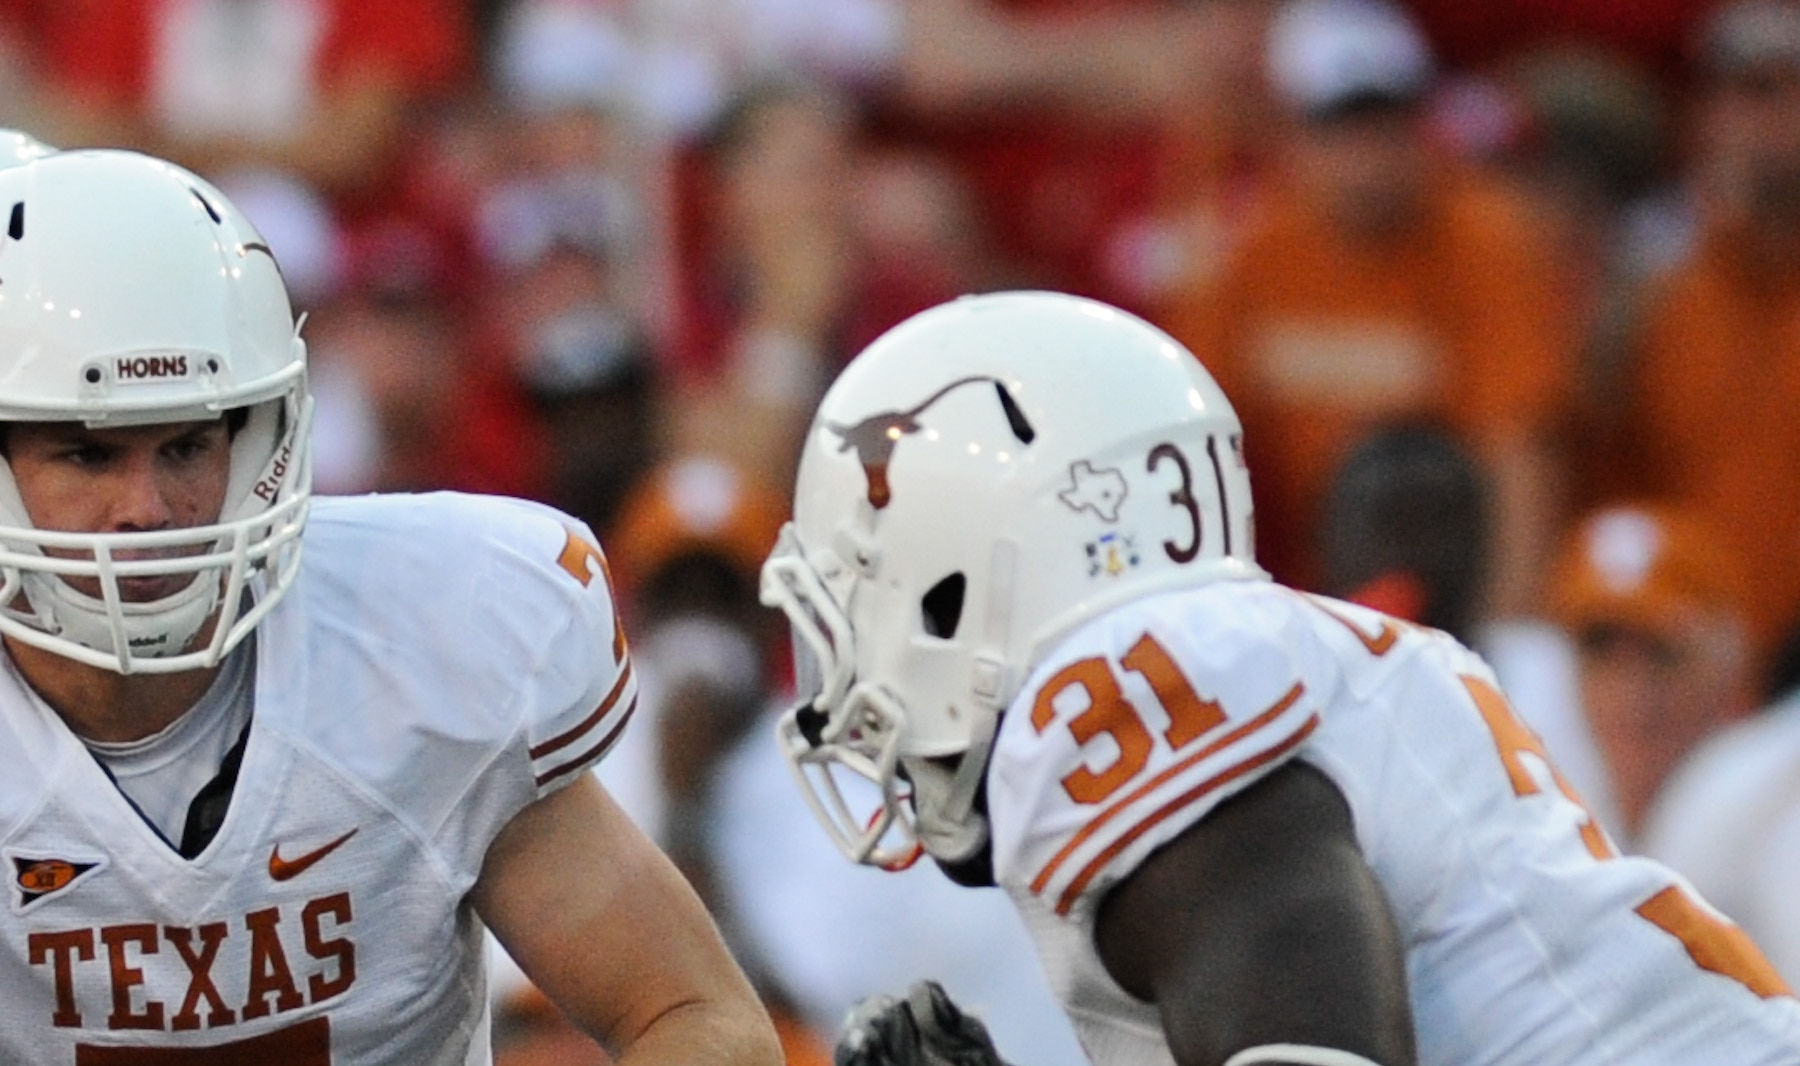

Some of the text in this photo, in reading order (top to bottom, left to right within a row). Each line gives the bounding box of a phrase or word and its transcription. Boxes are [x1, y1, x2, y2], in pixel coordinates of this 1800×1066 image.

[117, 355, 187, 379] HORNS
[1146, 433, 1231, 564] 31
[1030, 629, 1230, 805] 31
[28, 892, 356, 1031] TEXAS
